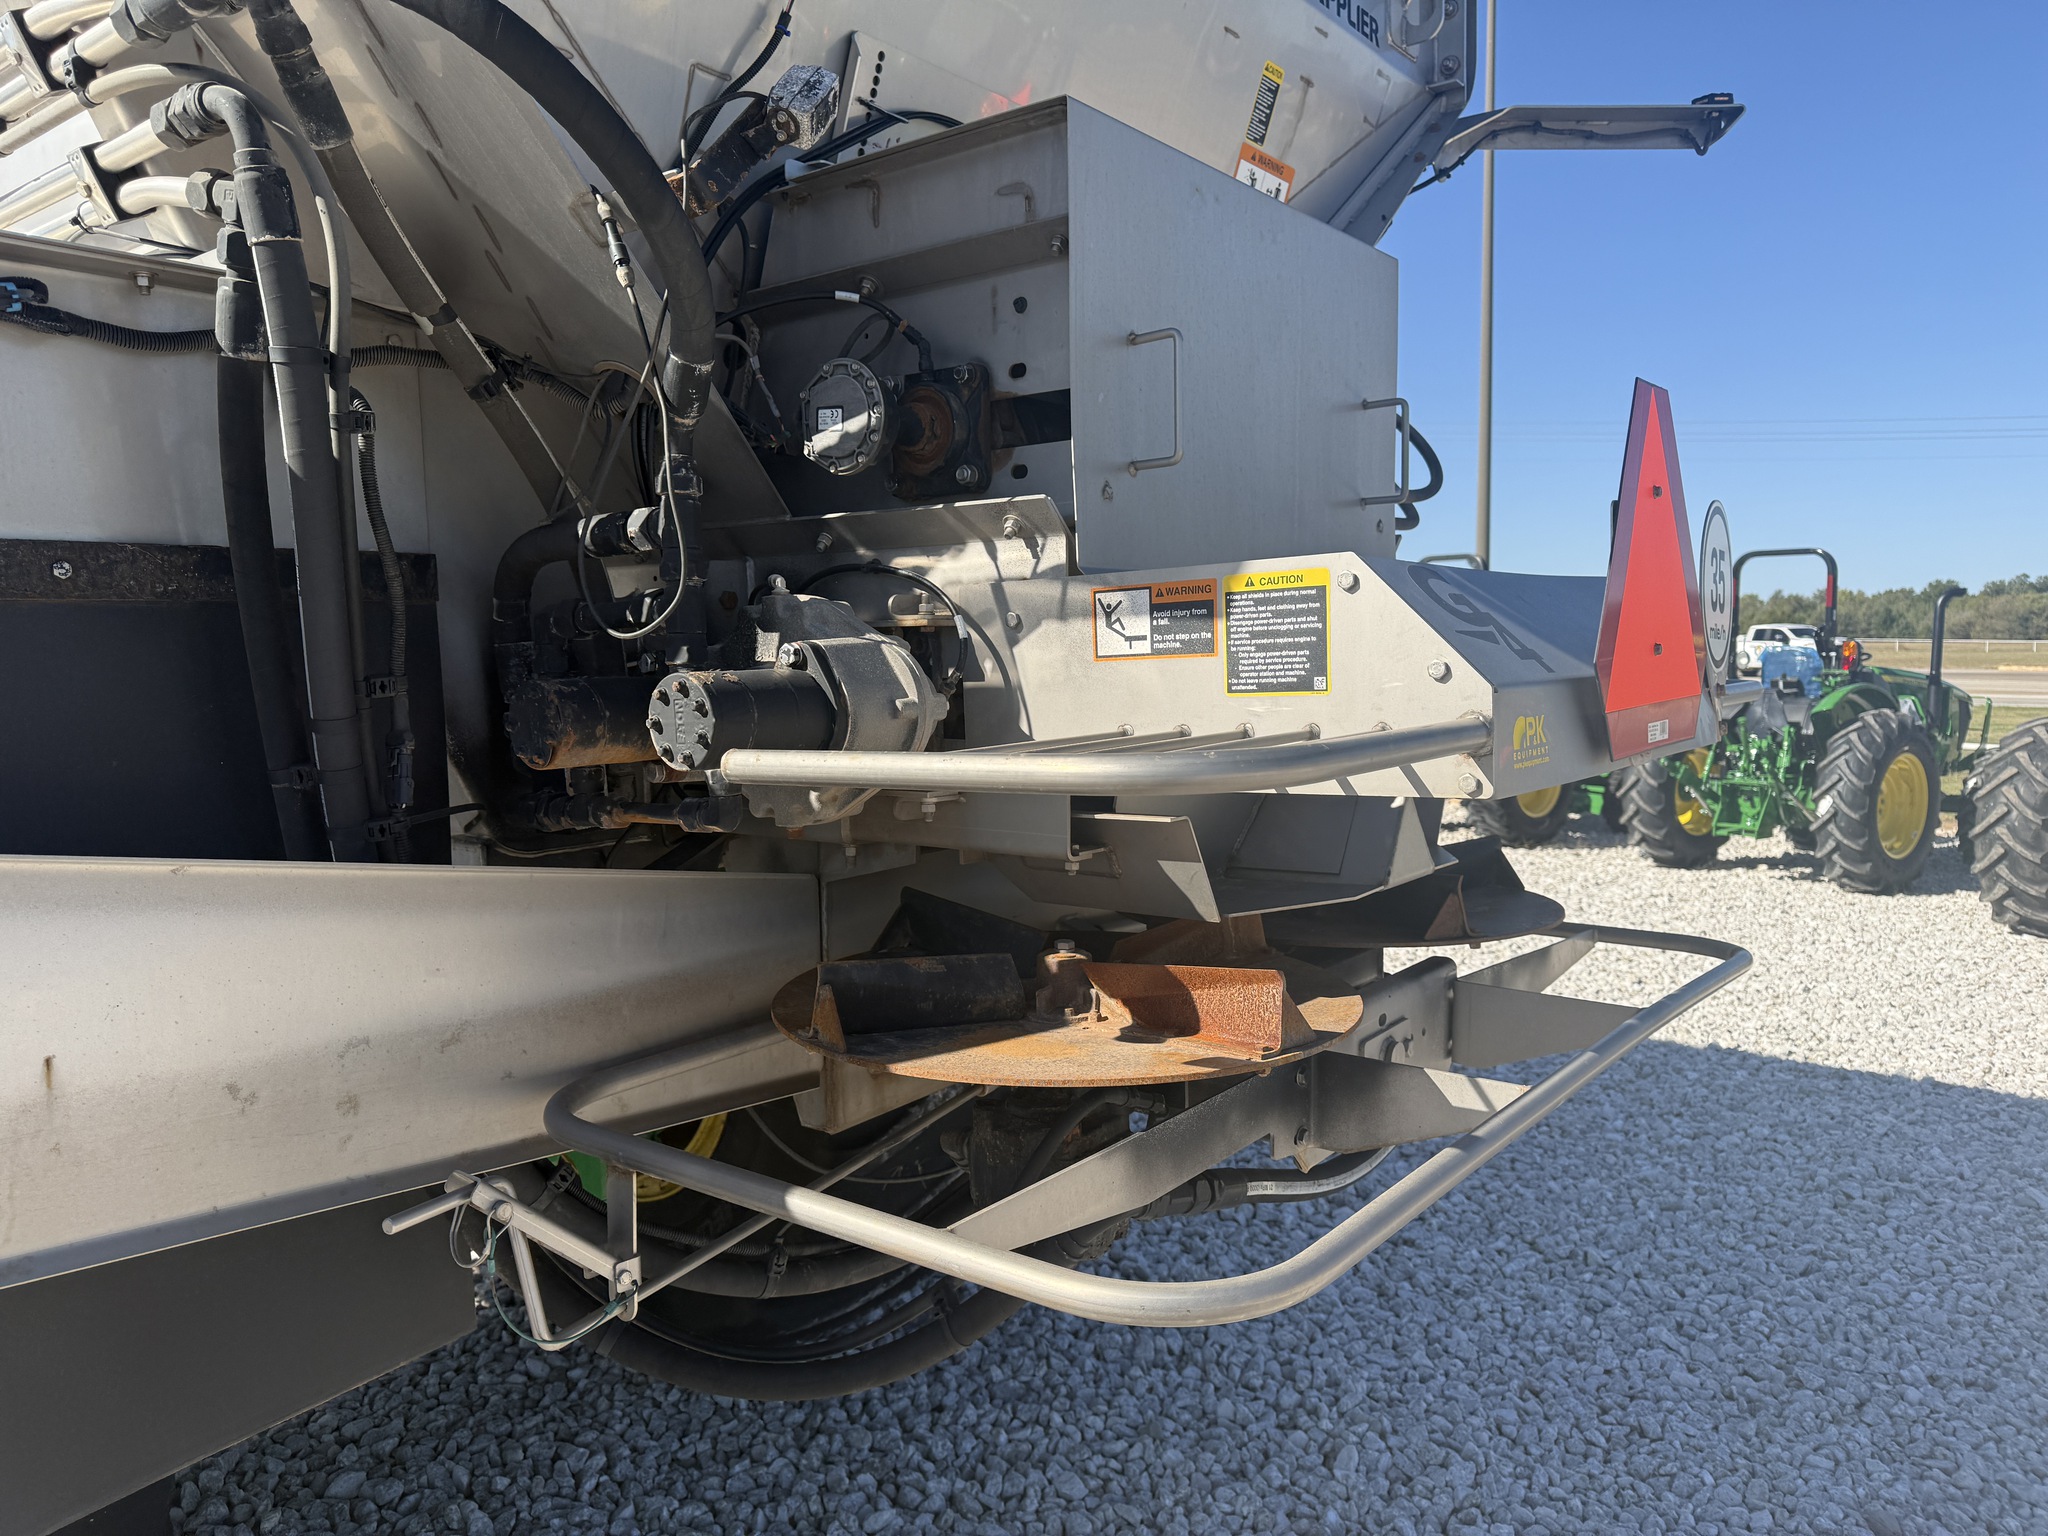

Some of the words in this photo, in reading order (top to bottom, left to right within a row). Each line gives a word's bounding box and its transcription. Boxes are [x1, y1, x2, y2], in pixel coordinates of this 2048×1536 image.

[1258, 154, 1284, 175] WARNING
[1259, 574, 1303, 586] CAUTION
[1711, 547, 1725, 614] 35
[1165, 584, 1212, 596] WARNING
[1153, 610, 1170, 618] Avoid
[1172, 609, 1190, 617] injury
[1175, 633, 1189, 641] step
[1710, 623, 1727, 641] mile/h
[1154, 641, 1182, 649] machine.
